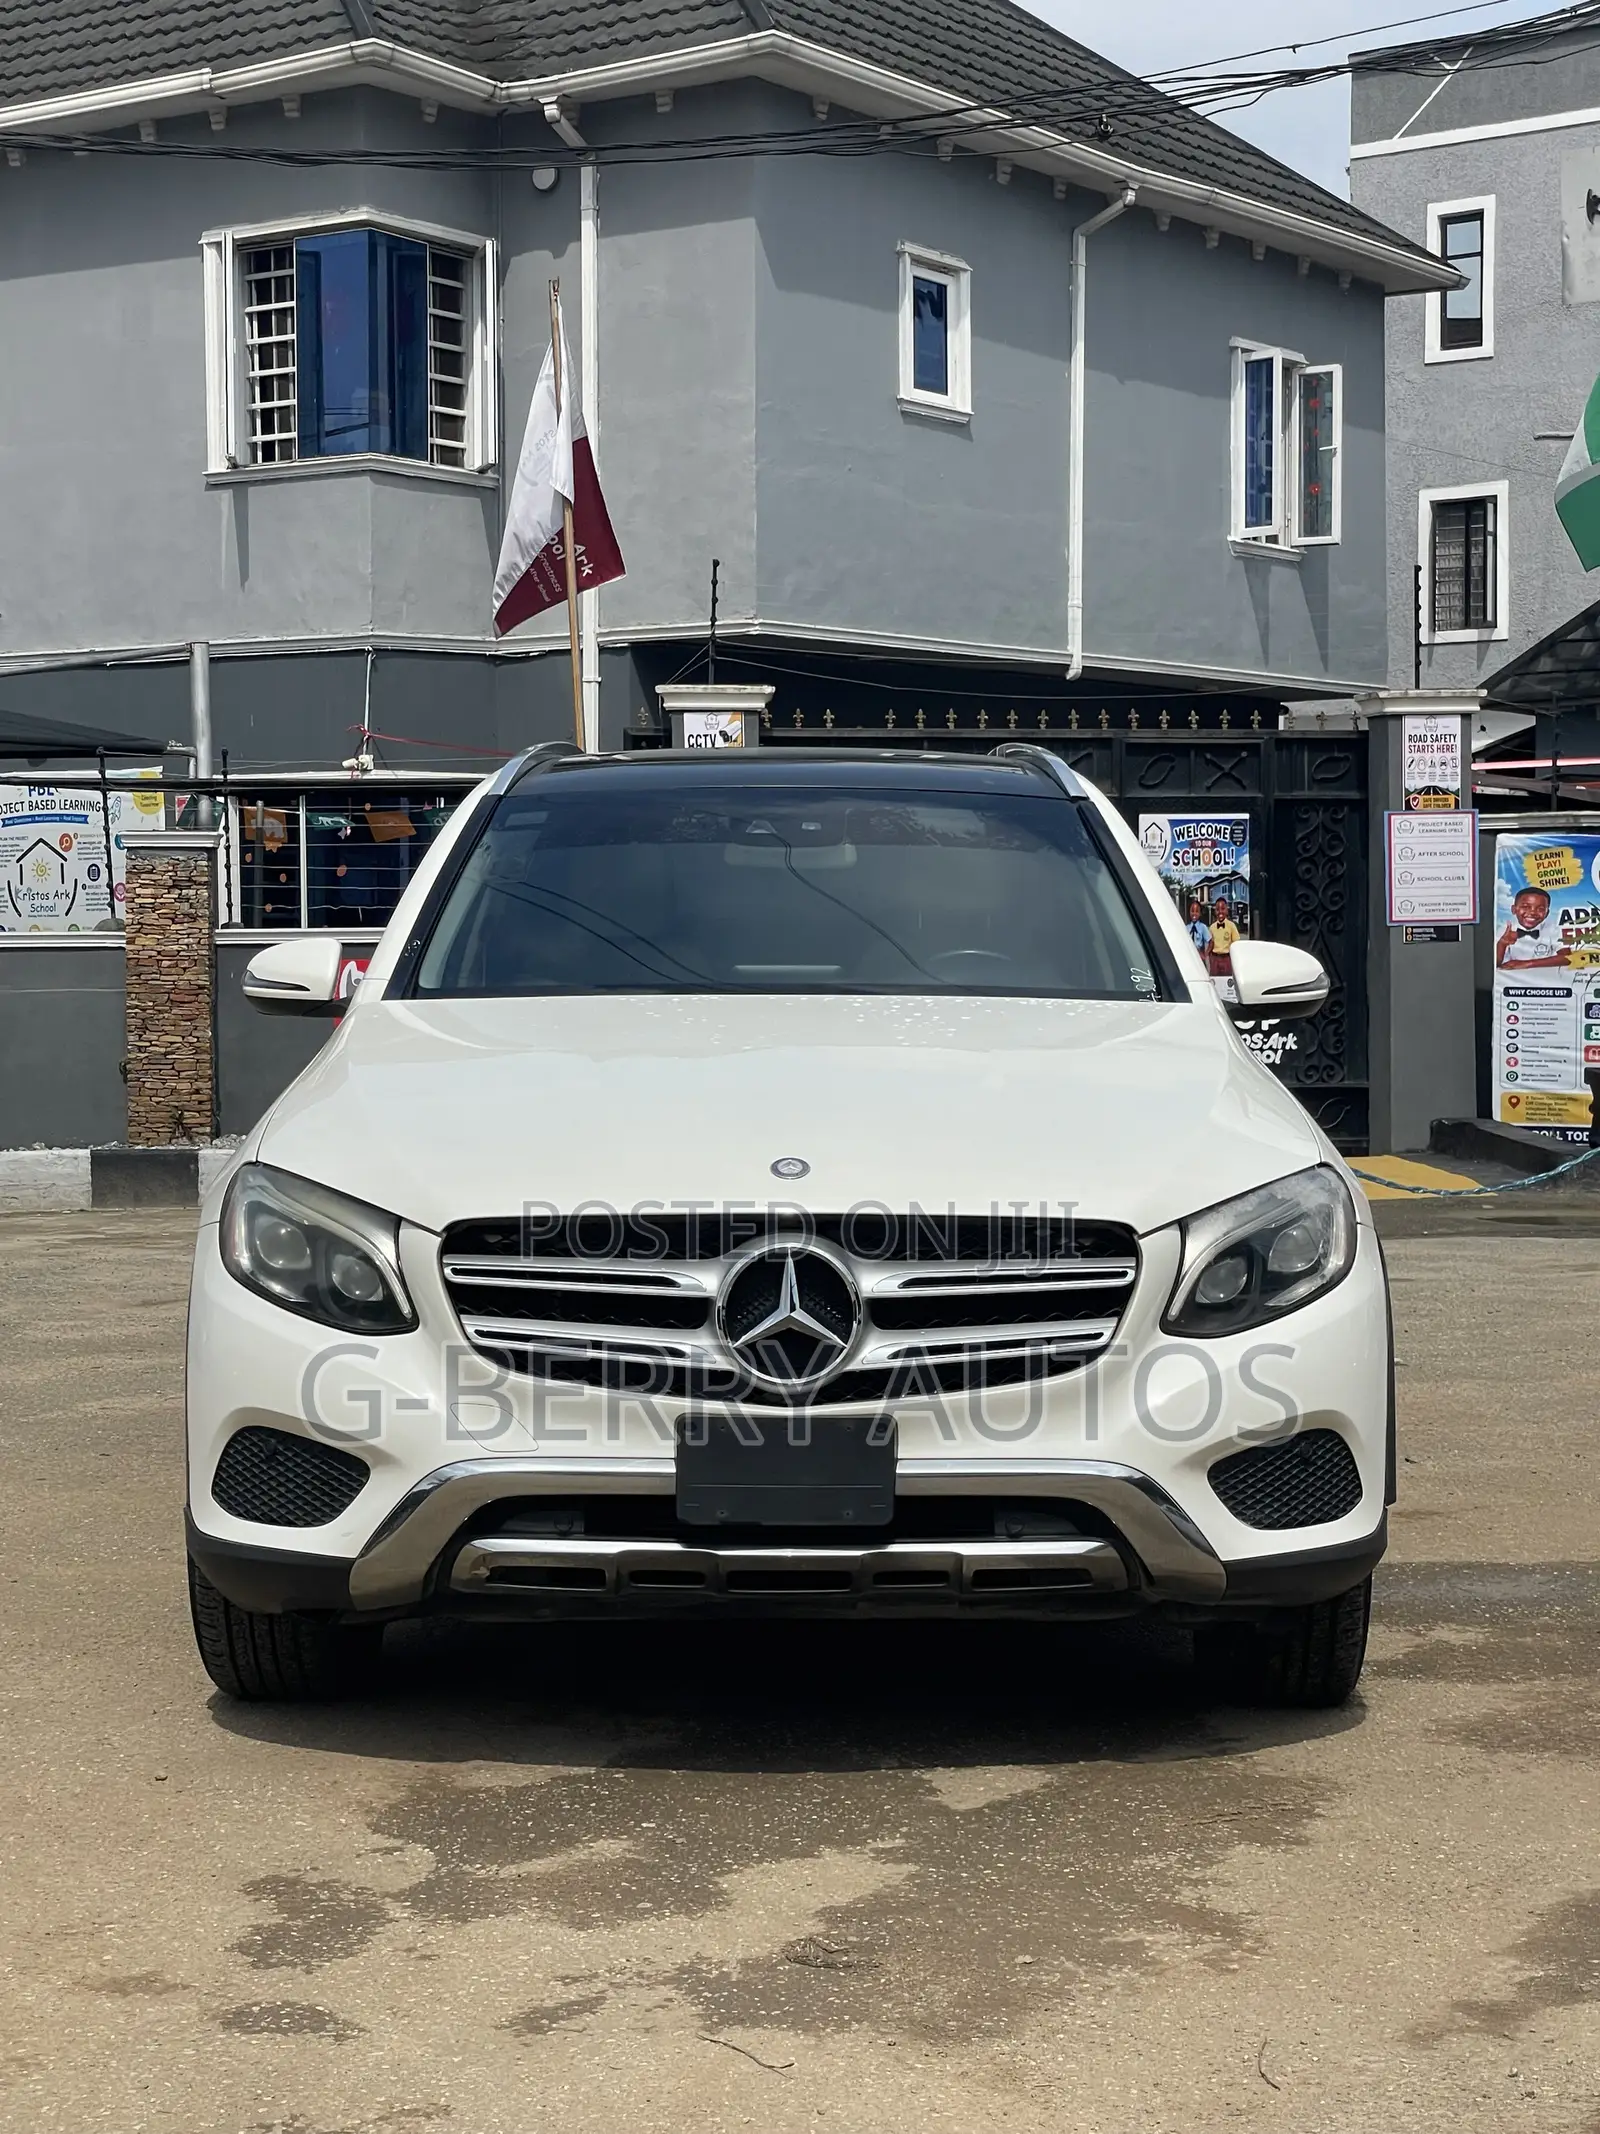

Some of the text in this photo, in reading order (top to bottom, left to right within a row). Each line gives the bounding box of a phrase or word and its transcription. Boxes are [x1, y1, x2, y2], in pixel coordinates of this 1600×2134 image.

[574, 544, 594, 577] Ark
[687, 734, 717, 748] CCTV
[1408, 734, 1457, 744] ROAD SAFETY
[1408, 744, 1457, 754] STARTS HERE!
[28, 799, 57, 812] BASED
[59, 799, 101, 813] LEARNING
[1174, 824, 1230, 842] WELCOME
[1172, 848, 1235, 867] SCHOOL!
[1534, 851, 1564, 861] LEARN!
[1537, 860, 1561, 870] PLAY!
[1538, 868, 1566, 878] GROW!
[1540, 877, 1570, 888] SHINE!
[15, 886, 49, 903] Kristos
[53, 890, 71, 900] Ark
[30, 903, 56, 913] School
